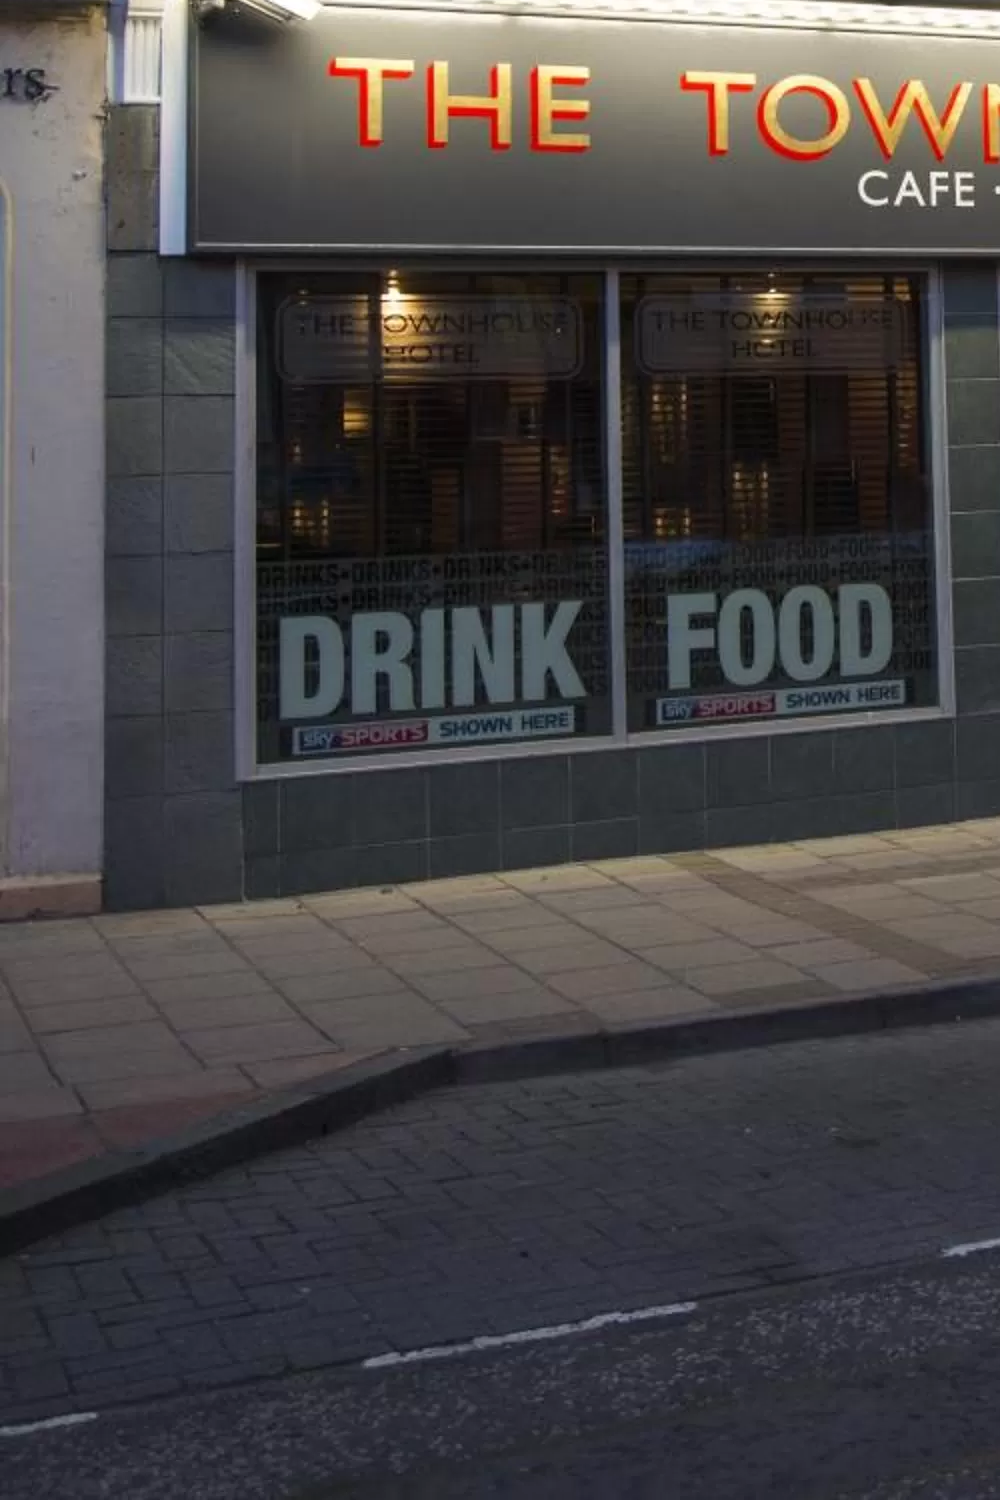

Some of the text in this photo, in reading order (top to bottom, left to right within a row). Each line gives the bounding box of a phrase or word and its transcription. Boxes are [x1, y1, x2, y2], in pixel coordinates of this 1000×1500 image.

[329, 57, 591, 152] THE
[857, 169, 975, 208] CAFE
[279, 600, 587, 720] DRINK
[667, 583, 893, 690] FOOD
[341, 722, 426, 747] SPORTS
[439, 715, 513, 738] SHOWN
[521, 710, 569, 730] HERE
[699, 693, 774, 716] SPORTS
[785, 687, 852, 709] SHOWN
[858, 682, 901, 702] HERE
